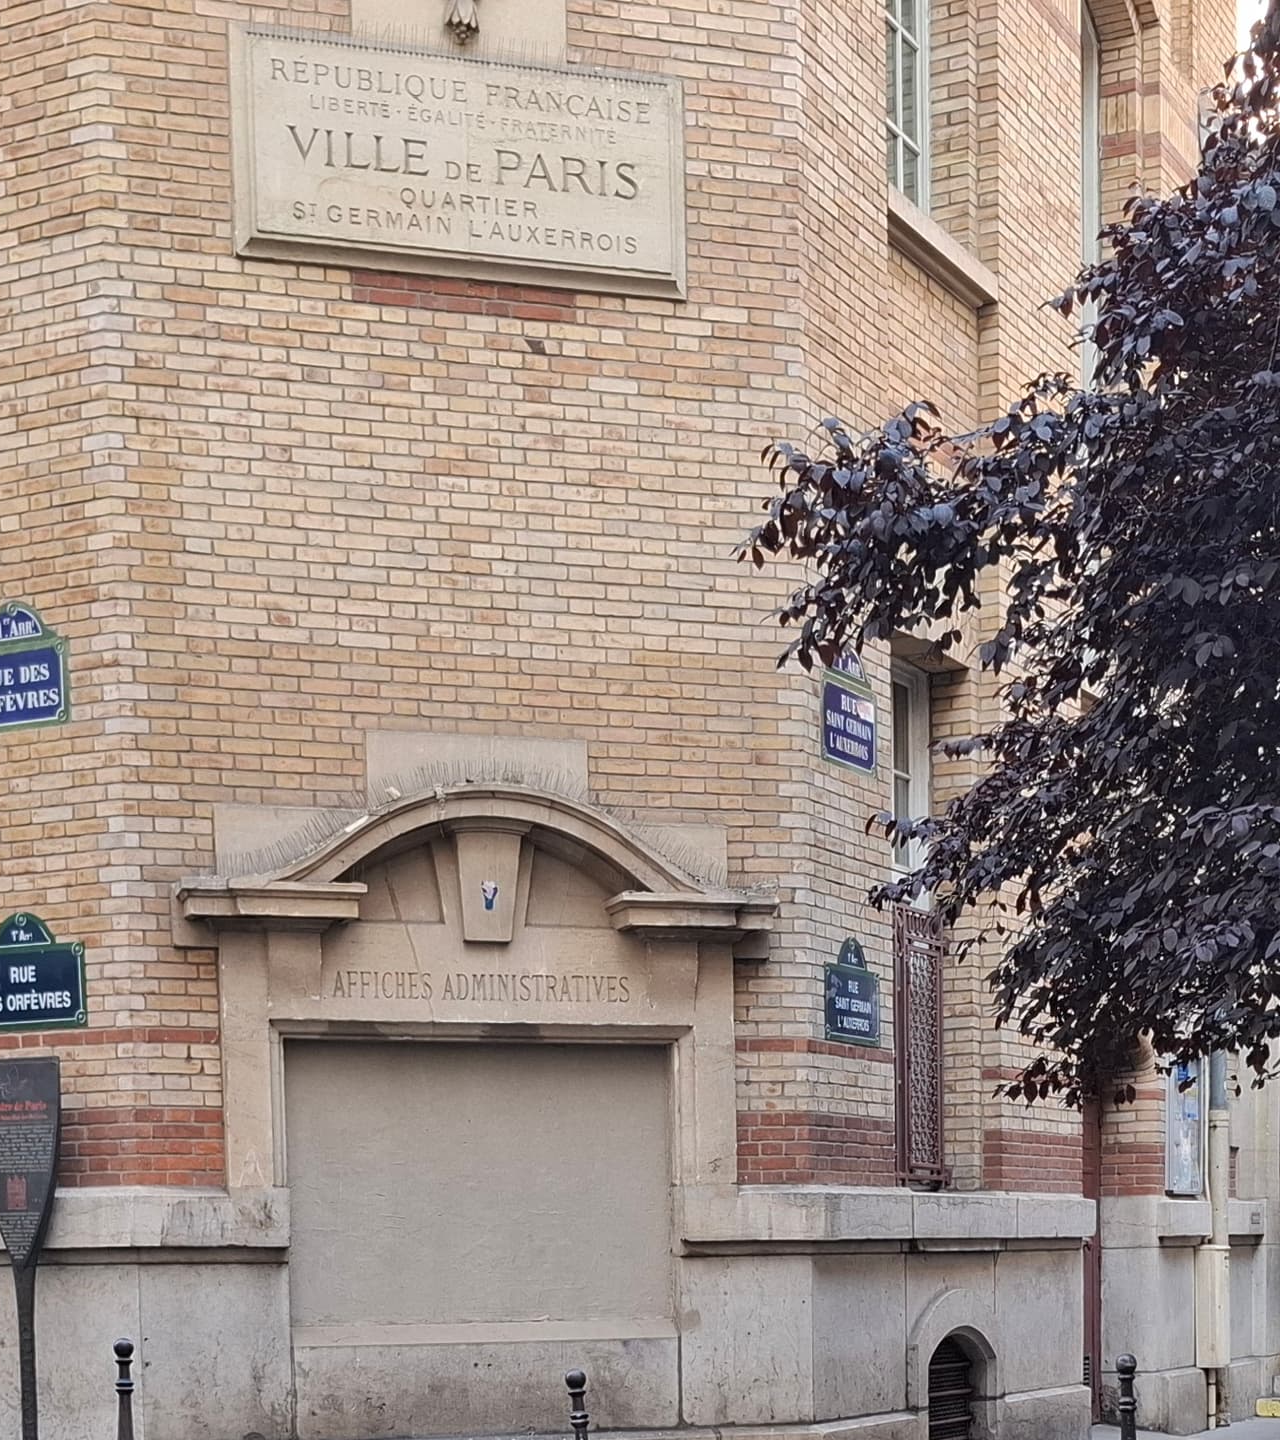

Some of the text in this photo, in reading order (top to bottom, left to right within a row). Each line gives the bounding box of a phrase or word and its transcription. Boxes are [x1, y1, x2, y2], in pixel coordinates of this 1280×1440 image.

[269, 56, 652, 125] RÉPUBLIQUE FRANÇAISE
[310, 94, 617, 145] LIBERTÉ ÉGALITÉ FRATERNITÉ
[285, 124, 641, 200] VILLE DE PARIS
[399, 187, 538, 219] QUARTIER
[327, 205, 451, 234] GERMAIN
[470, 219, 638, 255] L'AUXERROIS
[19, 663, 50, 684] DES
[841, 694, 857, 716] RUE
[826, 709, 844, 731] SAINT
[9, 965, 37, 984] RUE
[332, 970, 632, 1004] AFFICHES ADMINISTRATIVES
[848, 980, 860, 995] RUE
[6, 989, 72, 1012] ORFÈVRES
[835, 996, 851, 1011] SAINT
